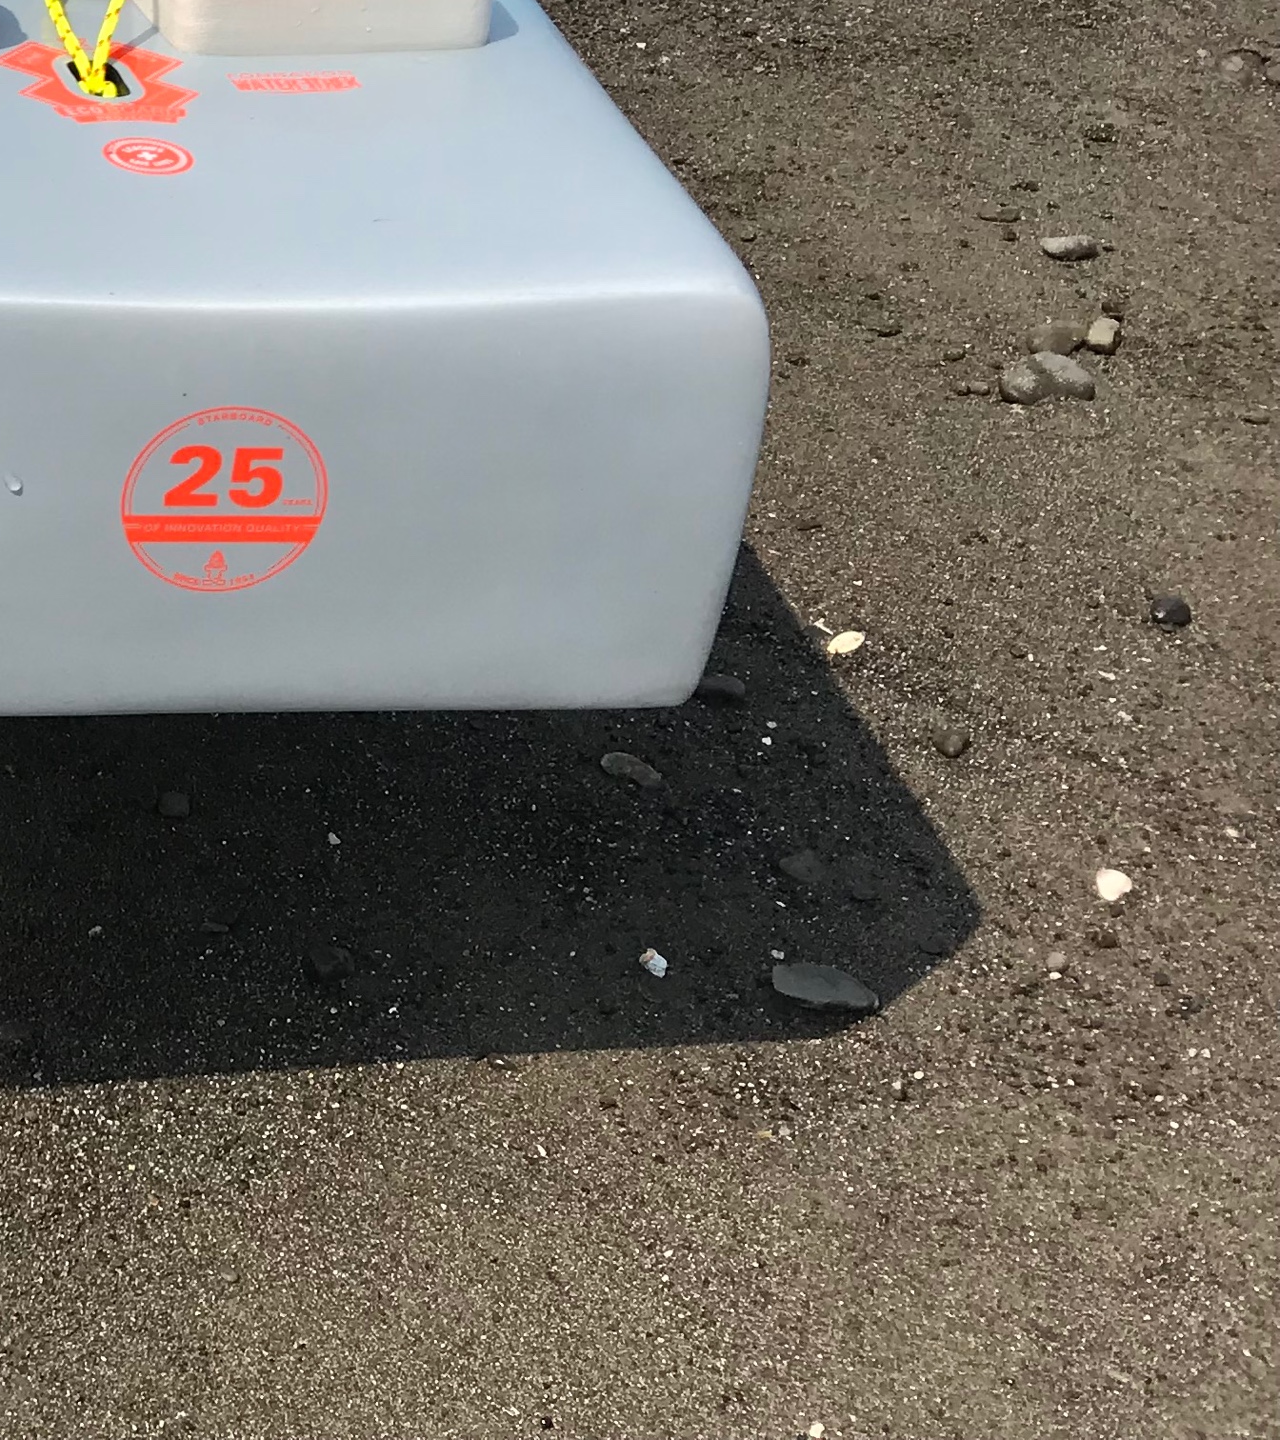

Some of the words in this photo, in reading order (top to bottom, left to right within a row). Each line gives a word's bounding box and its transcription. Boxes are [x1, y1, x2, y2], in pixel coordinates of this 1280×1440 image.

[163, 444, 284, 508] 25
[143, 522, 161, 533] OF
[164, 522, 242, 533] INNOVATION
[246, 522, 301, 533] QUALITY
